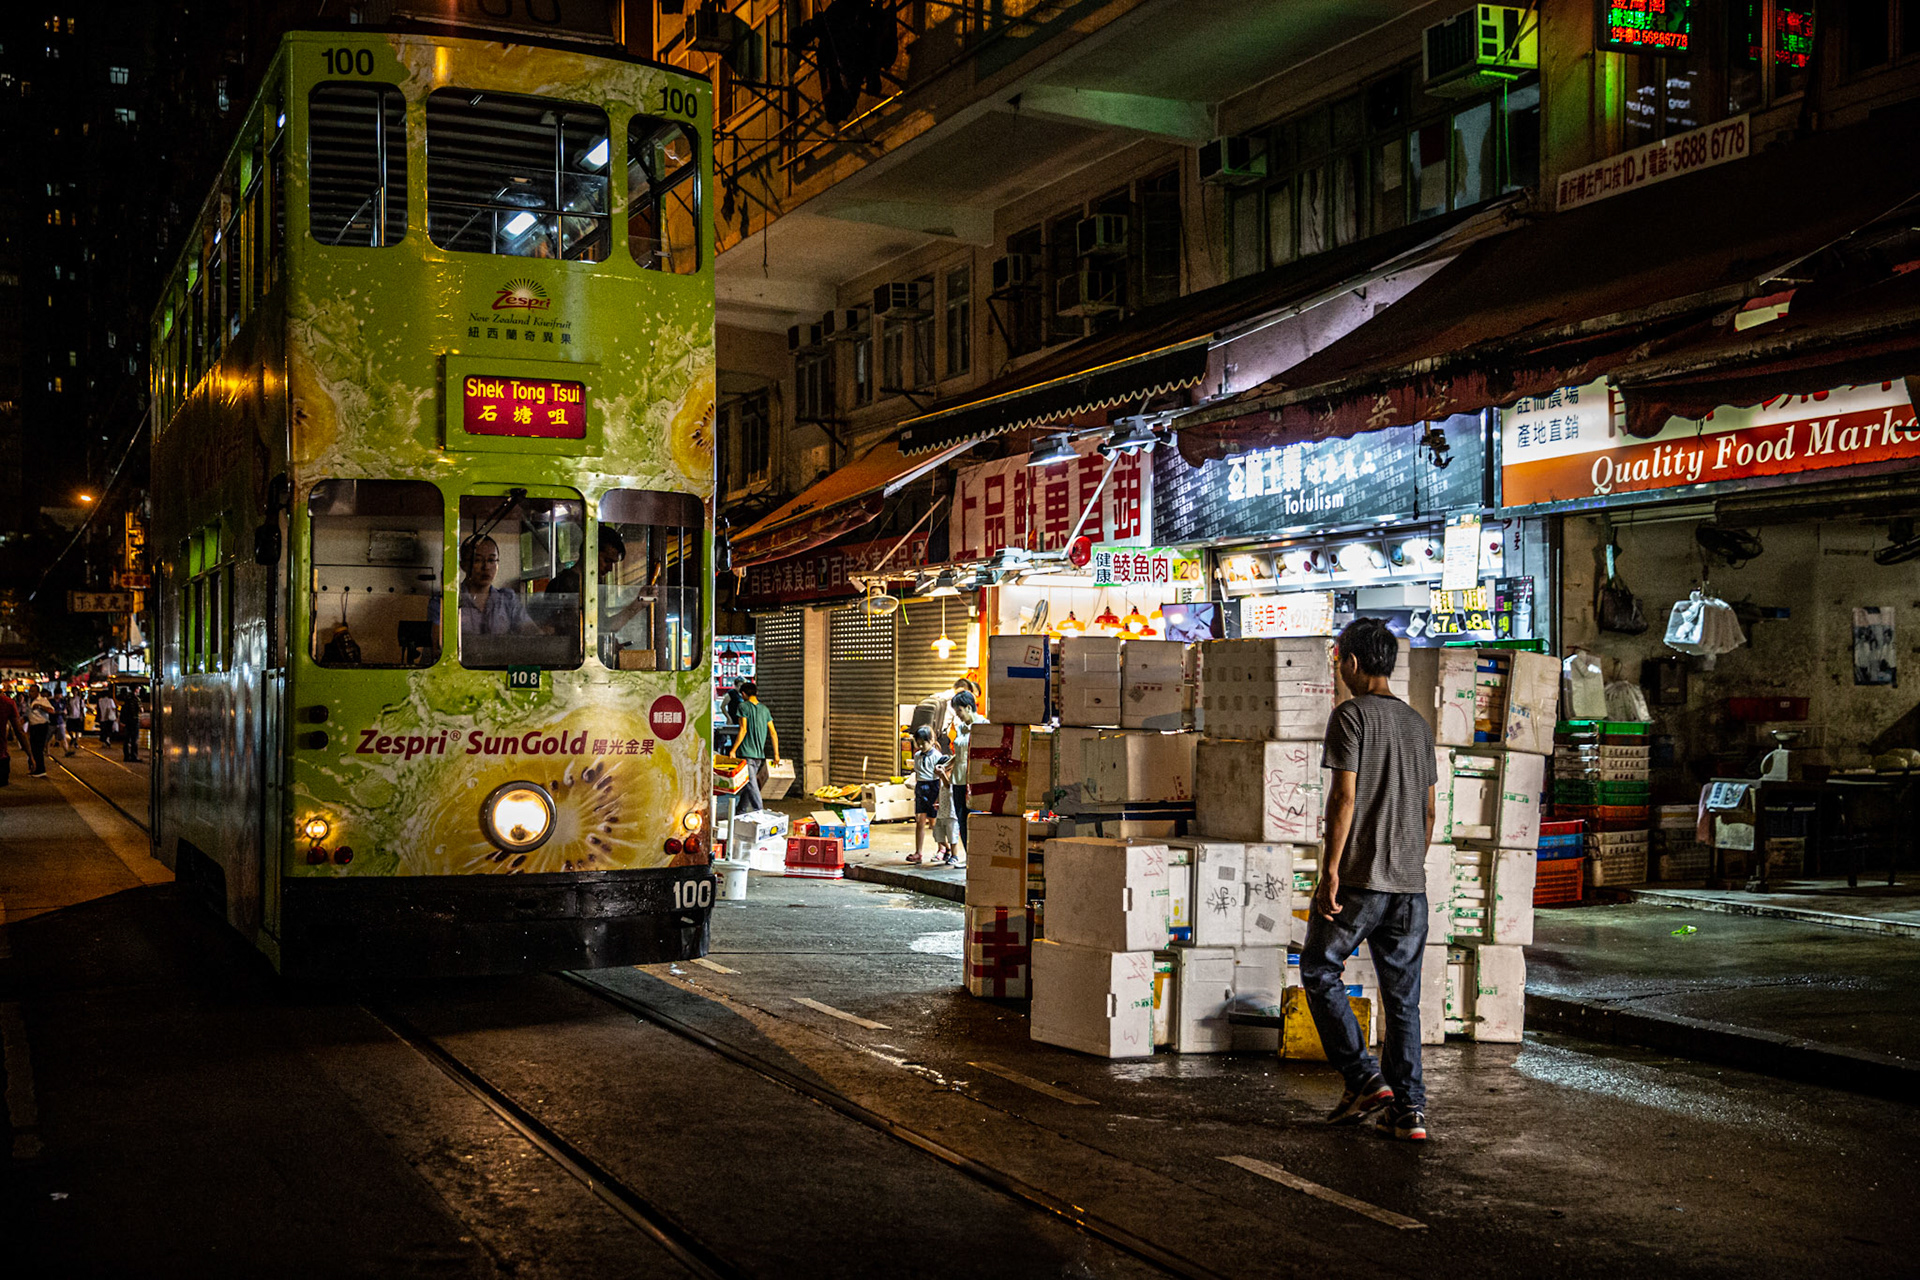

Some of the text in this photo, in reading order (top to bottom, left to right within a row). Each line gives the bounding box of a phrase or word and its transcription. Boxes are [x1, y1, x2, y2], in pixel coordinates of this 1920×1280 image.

[321, 48, 374, 75] 100
[659, 86, 697, 118] 100
[1711, 121, 1746, 160] 6778
[492, 291, 551, 311] Zespri
[468, 313, 572, 330] New Zealand Kiwifruit
[466, 378, 580, 404] Shek Tong Tsui
[478, 404, 569, 425] 石塘咀
[1517, 414, 1579, 448] 產地直銷
[1591, 444, 1704, 496] Quality
[1711, 425, 1795, 471] Food
[1283, 486, 1344, 515] Tofulism
[511, 671, 538, 685] 108
[466, 731, 588, 755] SunGold
[592, 739, 655, 755] 陽光金果
[673, 880, 712, 909] 100
